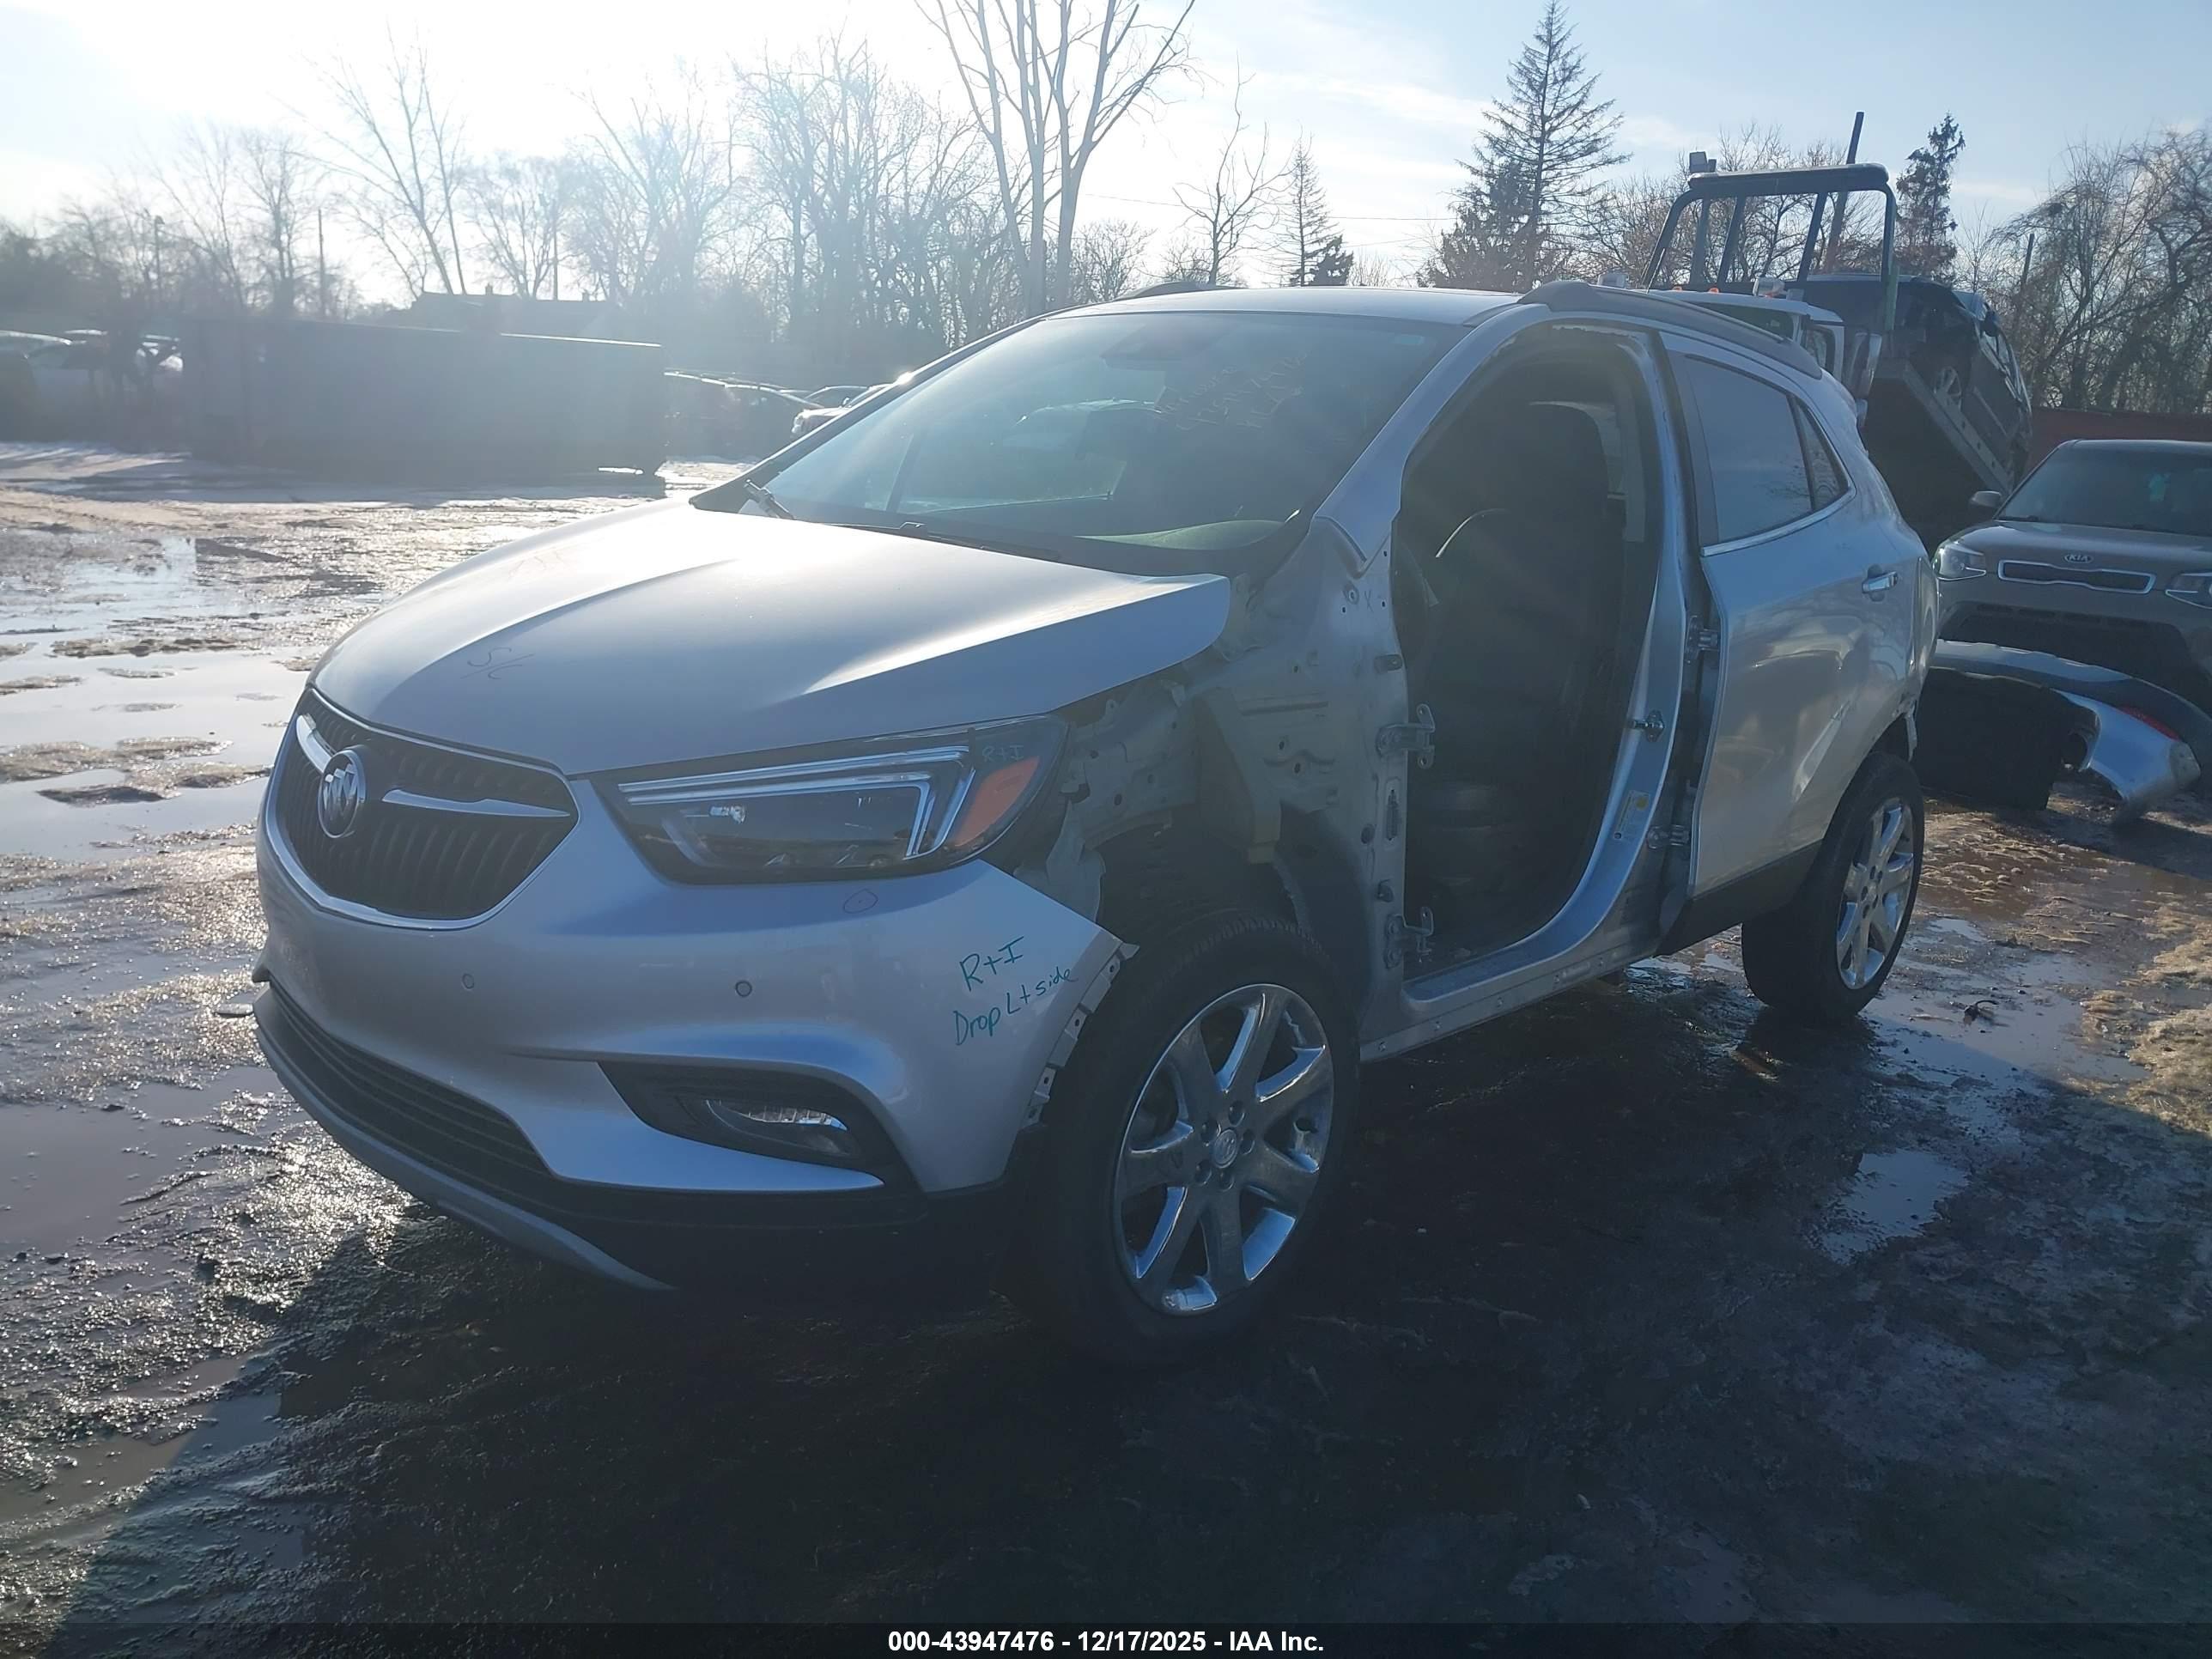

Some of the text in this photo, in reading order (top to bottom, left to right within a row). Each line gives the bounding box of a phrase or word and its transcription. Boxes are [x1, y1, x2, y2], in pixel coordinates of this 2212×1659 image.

[982, 744, 1024, 763] R+I
[959, 936, 1024, 992] R+I
[953, 1007, 1000, 1045] Drop
[1036, 966, 1079, 996] side
